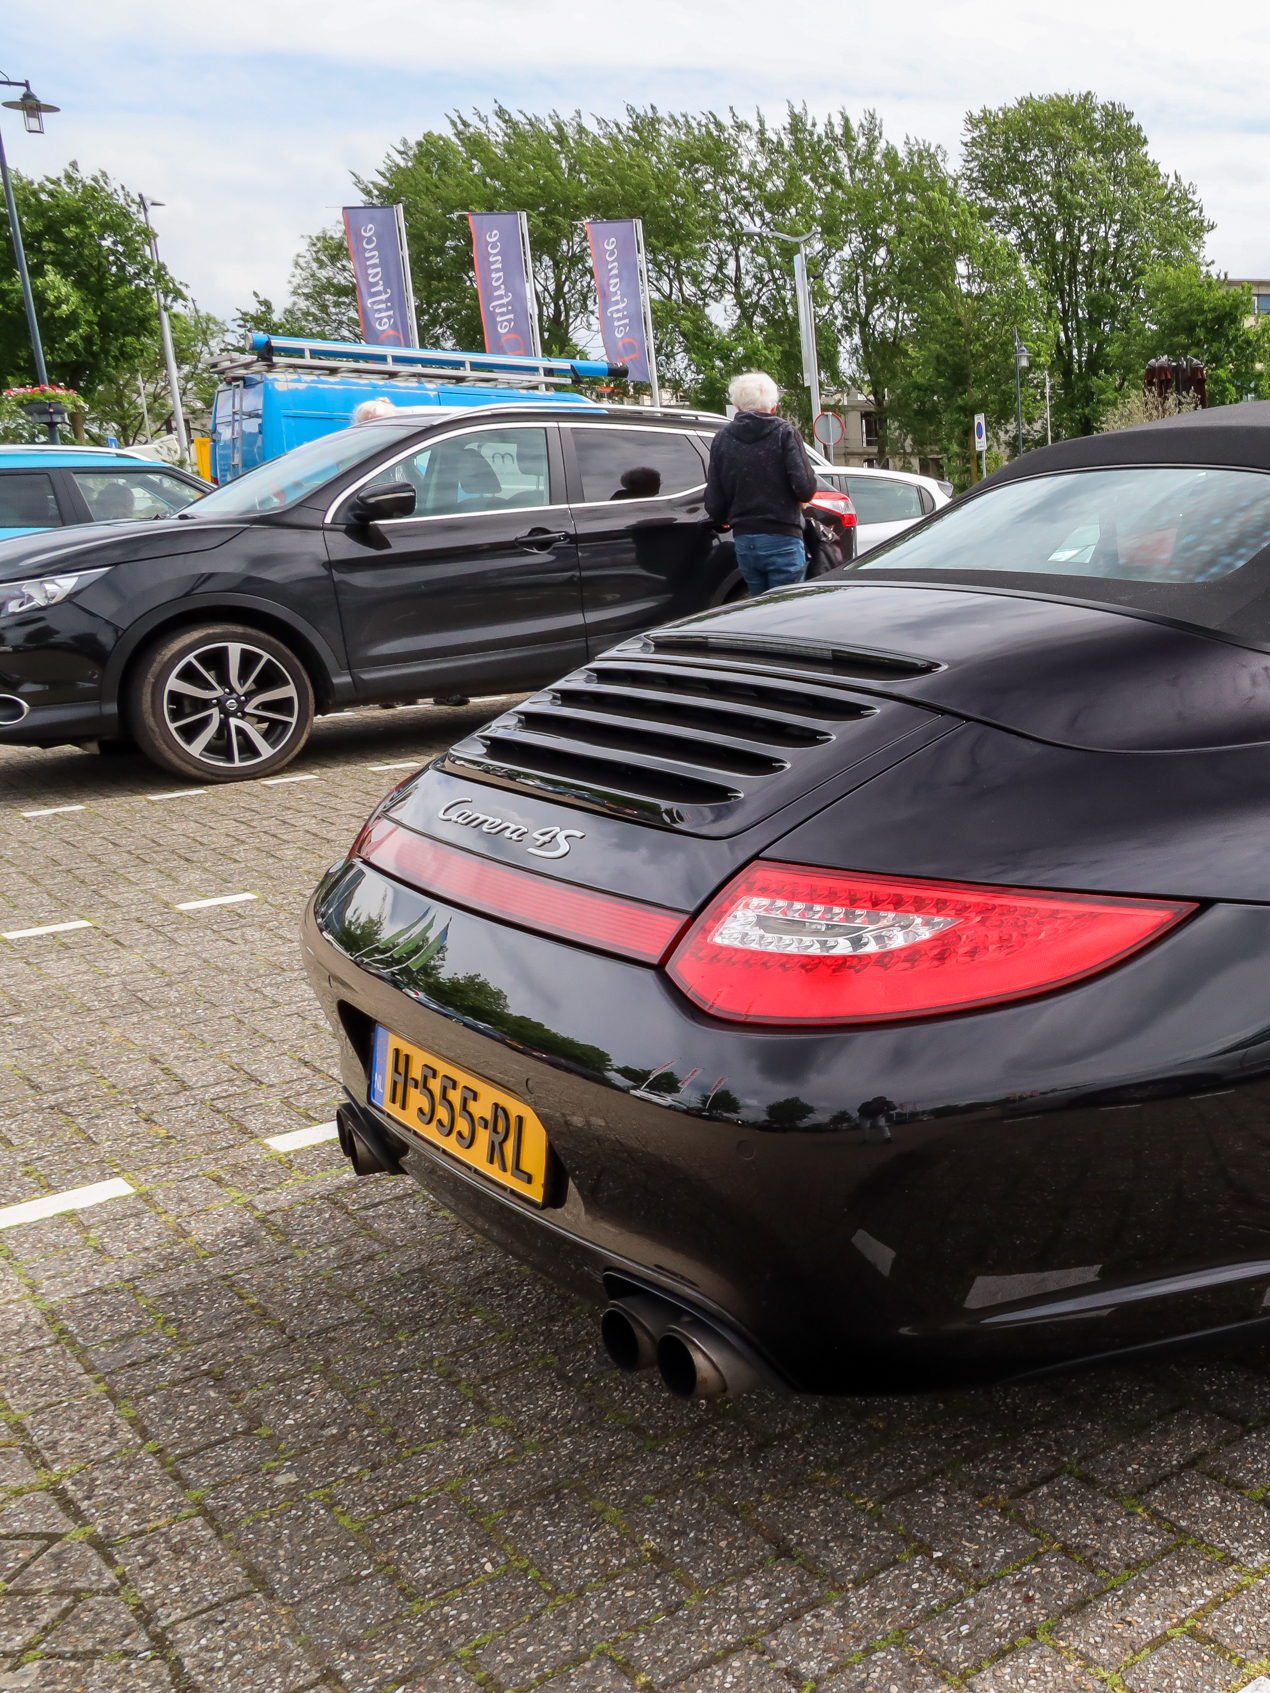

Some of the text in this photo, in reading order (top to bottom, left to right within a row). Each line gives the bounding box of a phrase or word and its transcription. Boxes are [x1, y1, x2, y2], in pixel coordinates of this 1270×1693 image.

[438, 797, 587, 860] Carrera 4S
[374, 1072, 384, 1093] NL
[388, 1047, 533, 1185] H-555-RL
